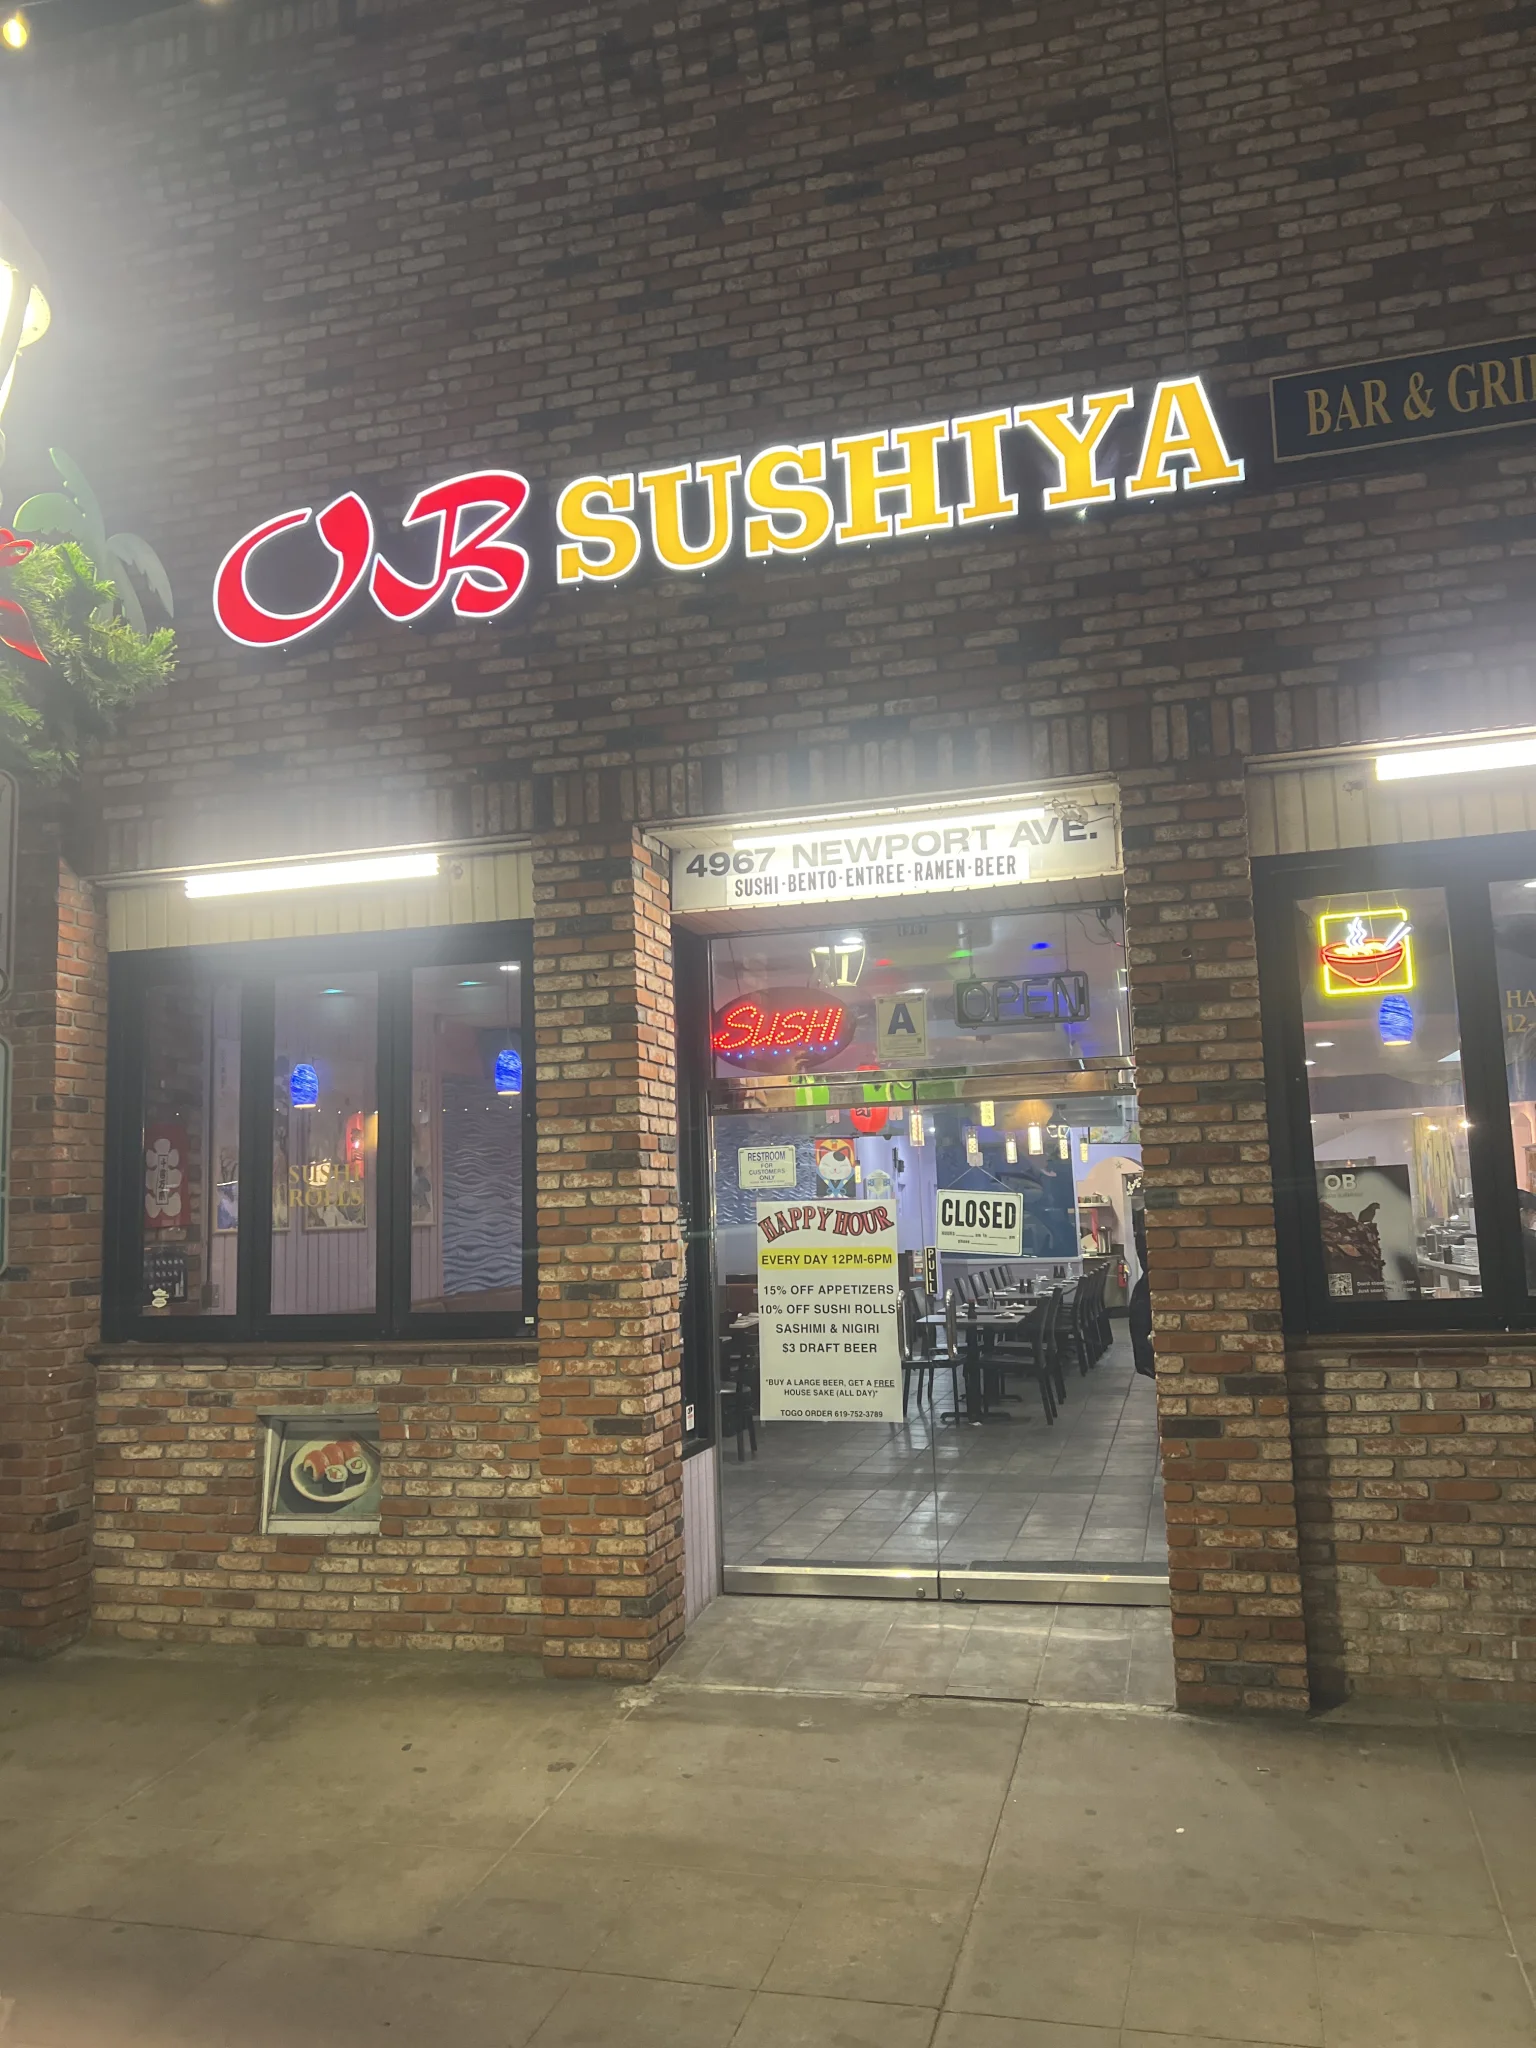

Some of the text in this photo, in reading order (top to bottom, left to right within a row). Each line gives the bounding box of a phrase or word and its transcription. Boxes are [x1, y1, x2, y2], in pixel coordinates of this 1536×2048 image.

[1304, 378, 1393, 437] BAR
[1402, 371, 1436, 422] &
[212, 375, 1245, 648] OB SUSHIYA
[686, 817, 1098, 878] 4967 NEWPORT AVE.
[974, 854, 1017, 877] BEER
[962, 976, 1081, 1022] OPEN
[717, 1004, 843, 1050] SUSHI
[887, 1002, 917, 1035] A
[747, 1150, 786, 1162] RESTROOM
[288, 1163, 361, 1184] SUSHI
[748, 1168, 786, 1176] CUSTOMERS
[1324, 1173, 1357, 1191] OB
[288, 1187, 364, 1208] ROLLS
[758, 1205, 895, 1243] HAPPY HOUR
[941, 1198, 1017, 1230] CLOSED
[761, 1253, 892, 1265] EVERY DAY 12PM-6PM
[927, 1248, 936, 1293] PULL
[763, 1284, 894, 1295] 15% OFF APPETIZERS
[759, 1303, 896, 1315] 10% OFF SUSHI ROLLS
[775, 1323, 880, 1334] SASHIMI & NIGIRI
[782, 1342, 878, 1354] $3 DRAFT BEER
[784, 1388, 811, 1397] HOUSE
[813, 1389, 834, 1397] SAKE
[836, 1389, 854, 1398] (ALL
[786, 1379, 792, 1387] A
[794, 1379, 821, 1387] LARGE
[822, 1379, 847, 1388] BEER,
[848, 1379, 864, 1387] GET
[866, 1379, 872, 1387] A
[873, 1379, 896, 1388] FREE
[780, 1409, 883, 1418] TOGO ORDER 619-752-3789
